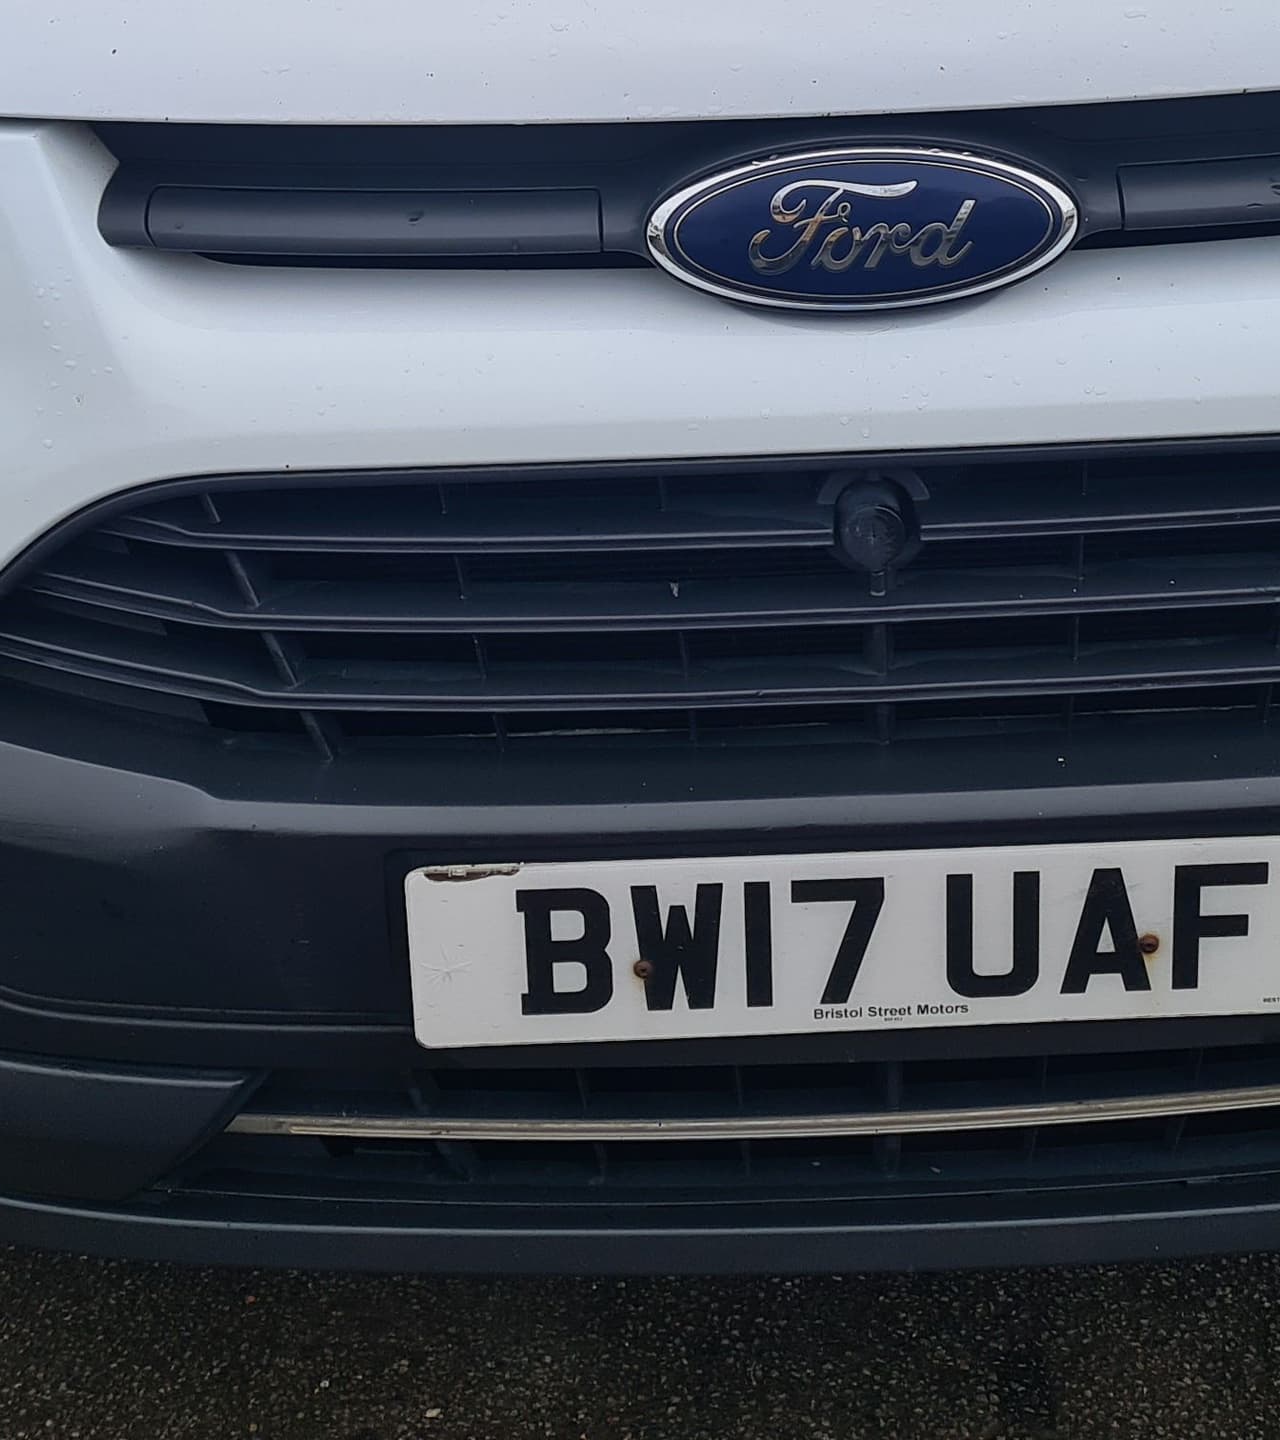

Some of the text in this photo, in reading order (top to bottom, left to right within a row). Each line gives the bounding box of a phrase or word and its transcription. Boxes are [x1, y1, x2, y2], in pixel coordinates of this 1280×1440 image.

[748, 180, 977, 276] Ford
[514, 861, 1270, 1016] BW17 UAF
[814, 1004, 969, 1020] Bristol Street Motors
